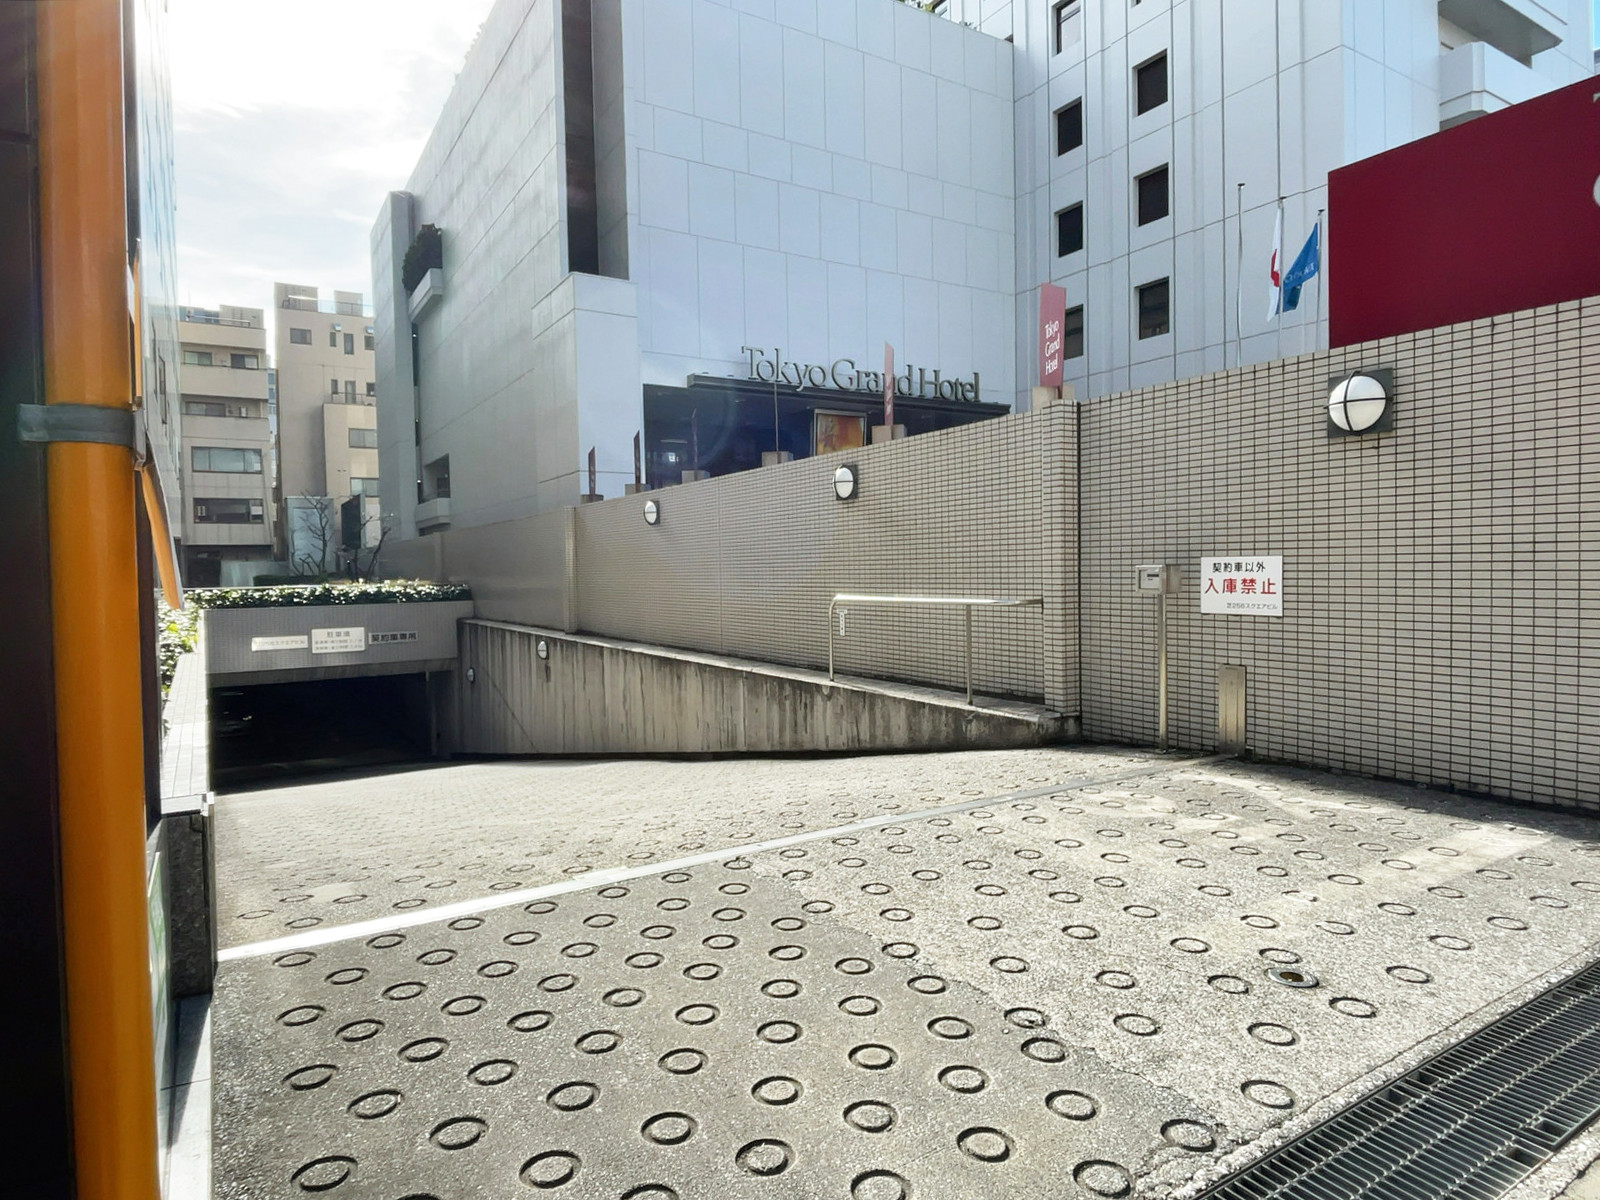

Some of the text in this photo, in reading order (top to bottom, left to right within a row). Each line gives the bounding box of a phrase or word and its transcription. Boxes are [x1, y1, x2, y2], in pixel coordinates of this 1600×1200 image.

[1045, 320, 1060, 339] Tokyo
[1045, 333, 1061, 357] Grand
[741, 345, 826, 392] Tokyo
[918, 367, 980, 402] Hotel
[1045, 353, 1058, 376] Hotel
[1212, 561, 1266, 573] 契約車以外
[1204, 577, 1277, 595] 入庫禁止
